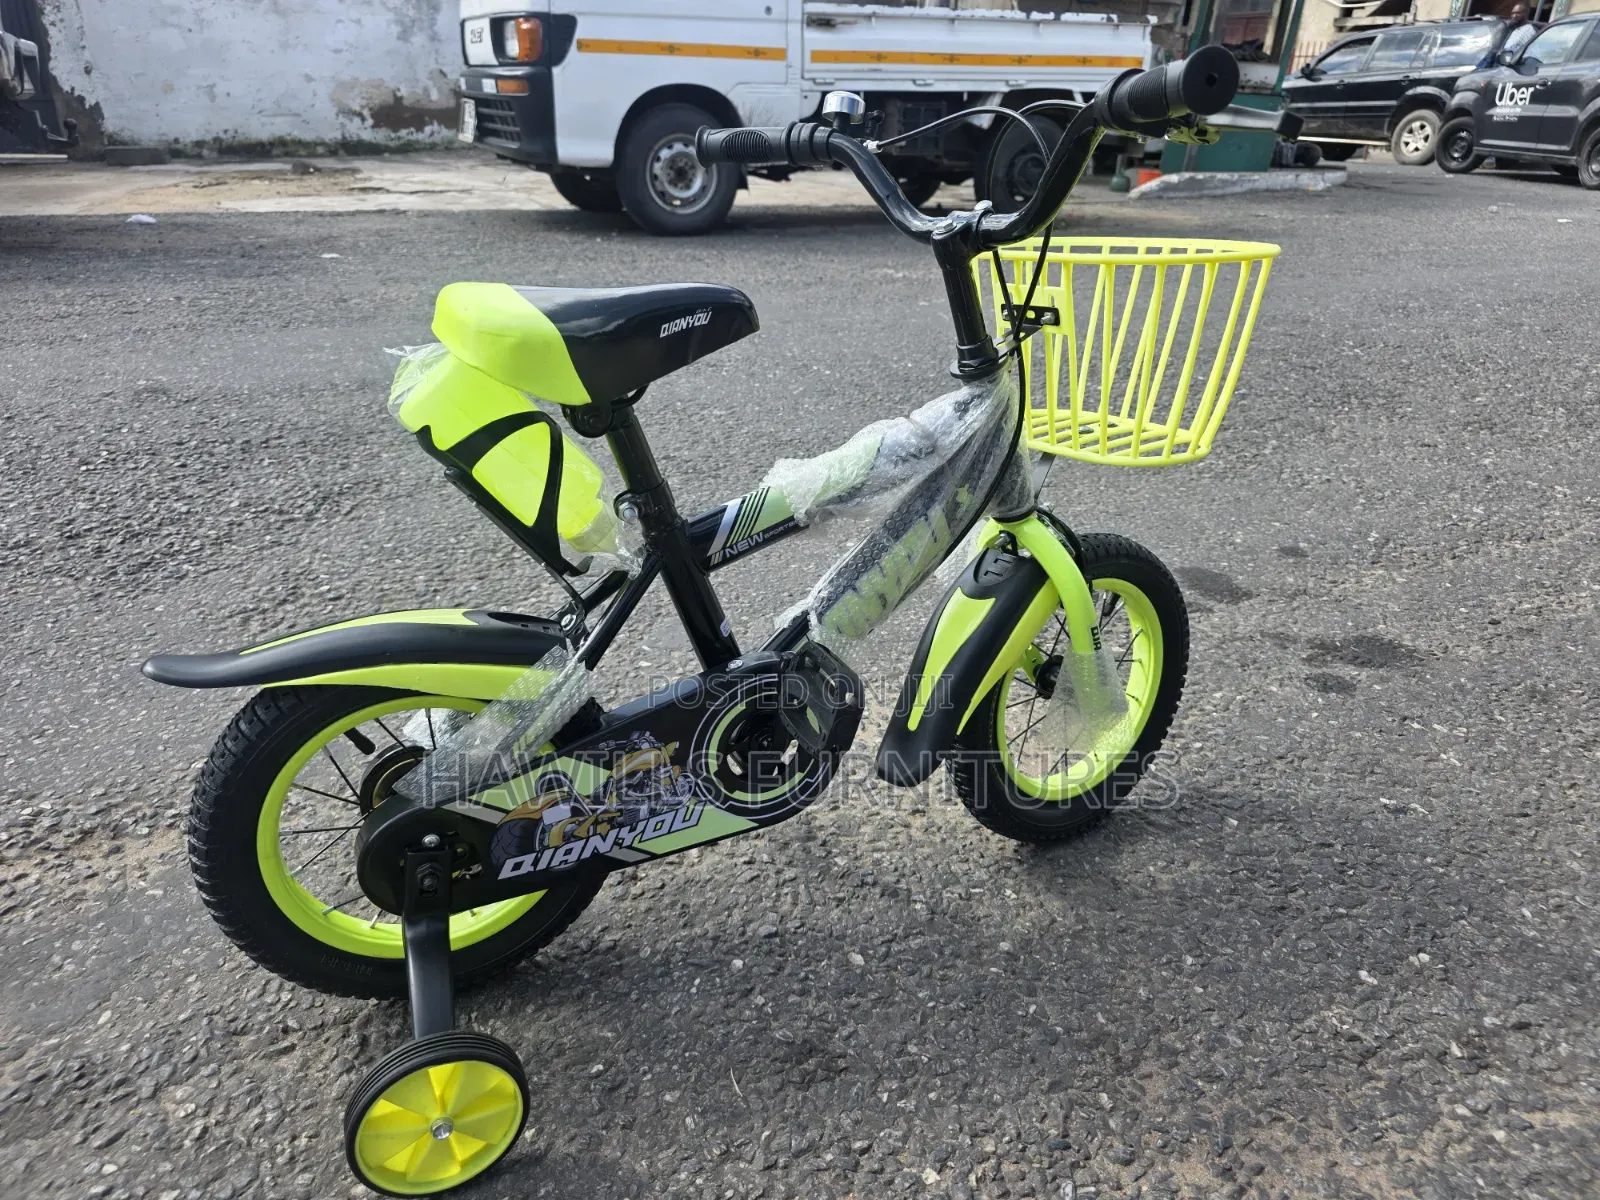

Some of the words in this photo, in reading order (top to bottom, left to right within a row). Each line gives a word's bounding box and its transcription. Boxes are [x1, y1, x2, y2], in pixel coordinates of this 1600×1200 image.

[1495, 82, 1534, 106] Uber
[660, 311, 712, 338] QIANYOU
[725, 532, 765, 559] NEW
[497, 801, 706, 880] QIANYOU
